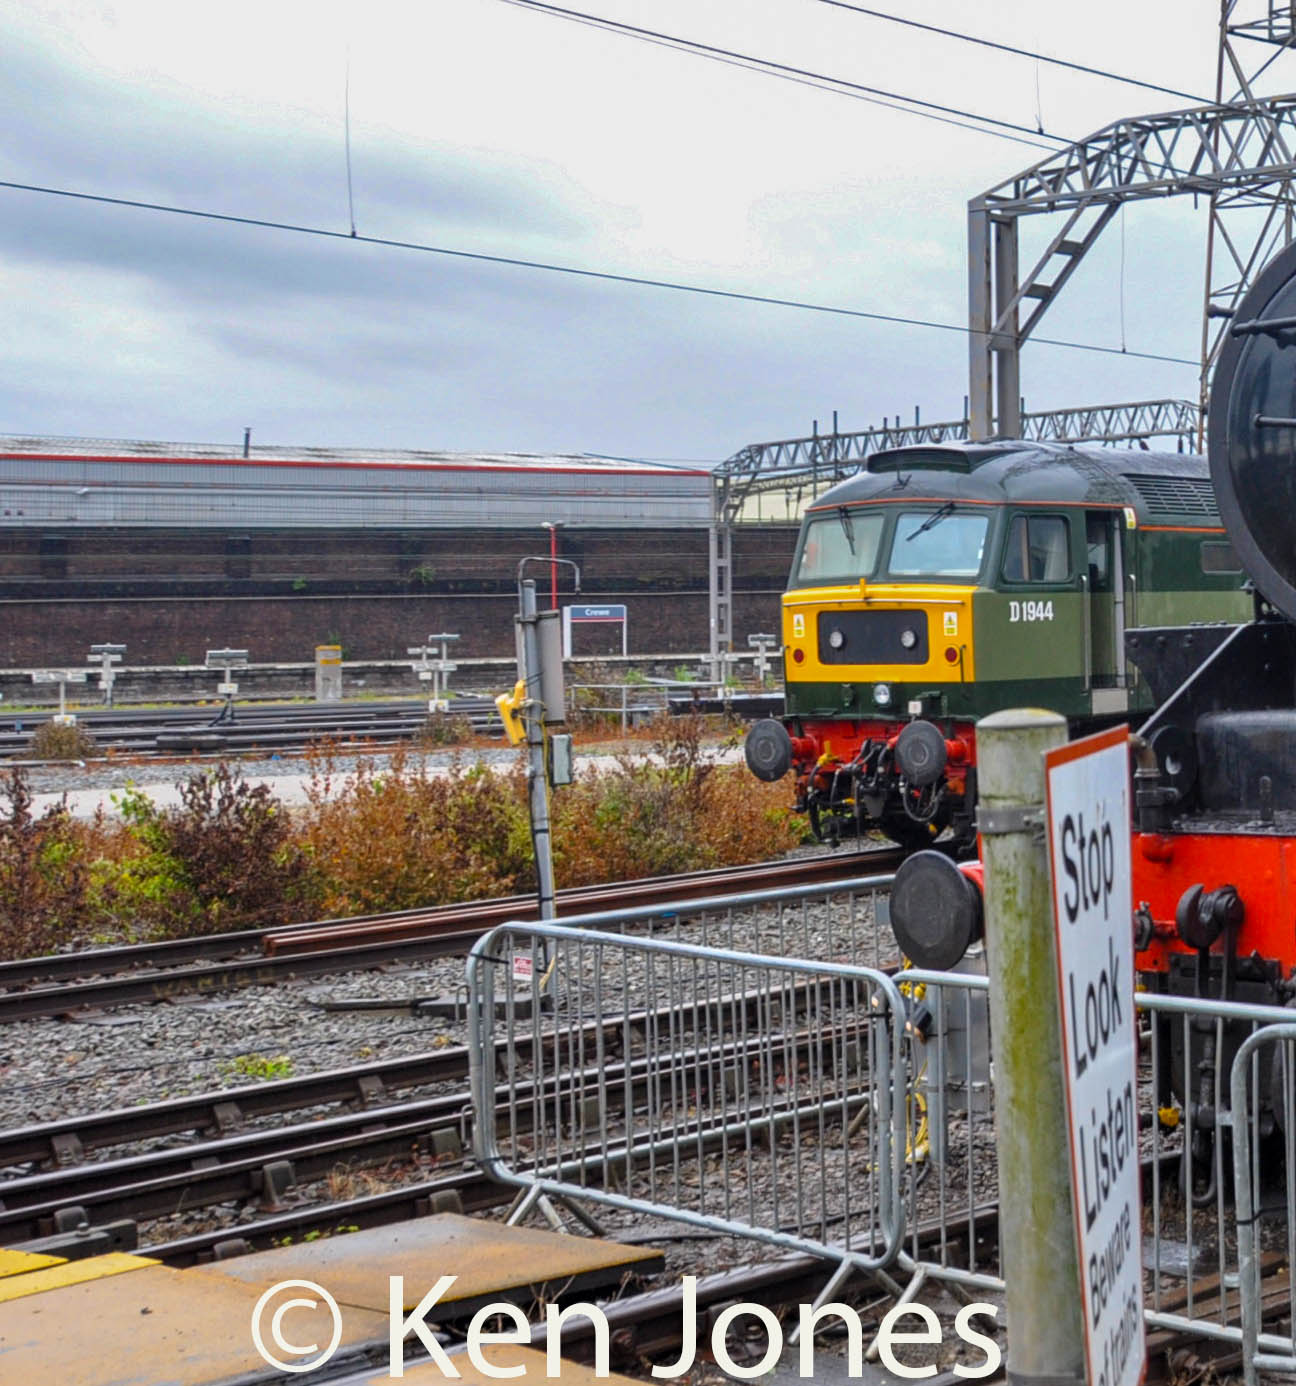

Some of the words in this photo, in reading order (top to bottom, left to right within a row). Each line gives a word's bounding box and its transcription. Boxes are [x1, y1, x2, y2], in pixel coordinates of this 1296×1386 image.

[584, 608, 610, 616] Crewe
[1062, 812, 1115, 924] Stop
[1069, 935, 1122, 1080] Look
[1079, 1080, 1135, 1234] Listen
[1089, 1200, 1131, 1331] Beware
[1110, 1283, 1137, 1386] trains
